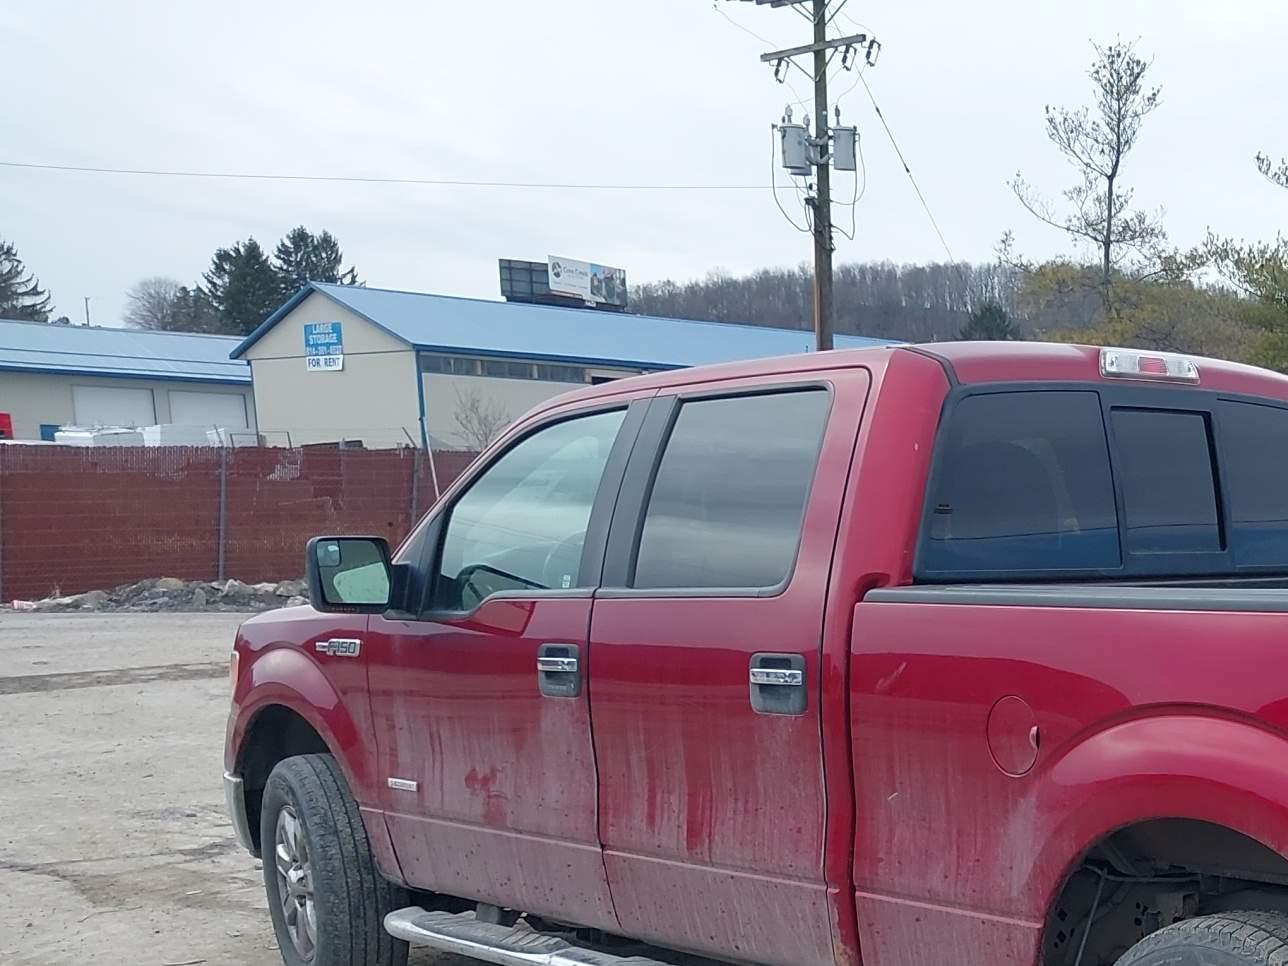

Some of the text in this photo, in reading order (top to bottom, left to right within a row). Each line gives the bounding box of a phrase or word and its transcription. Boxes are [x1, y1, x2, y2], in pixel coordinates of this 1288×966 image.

[312, 323, 333, 334] LARGE
[309, 333, 338, 345] STORAGE
[308, 357, 341, 368] FOR RENT
